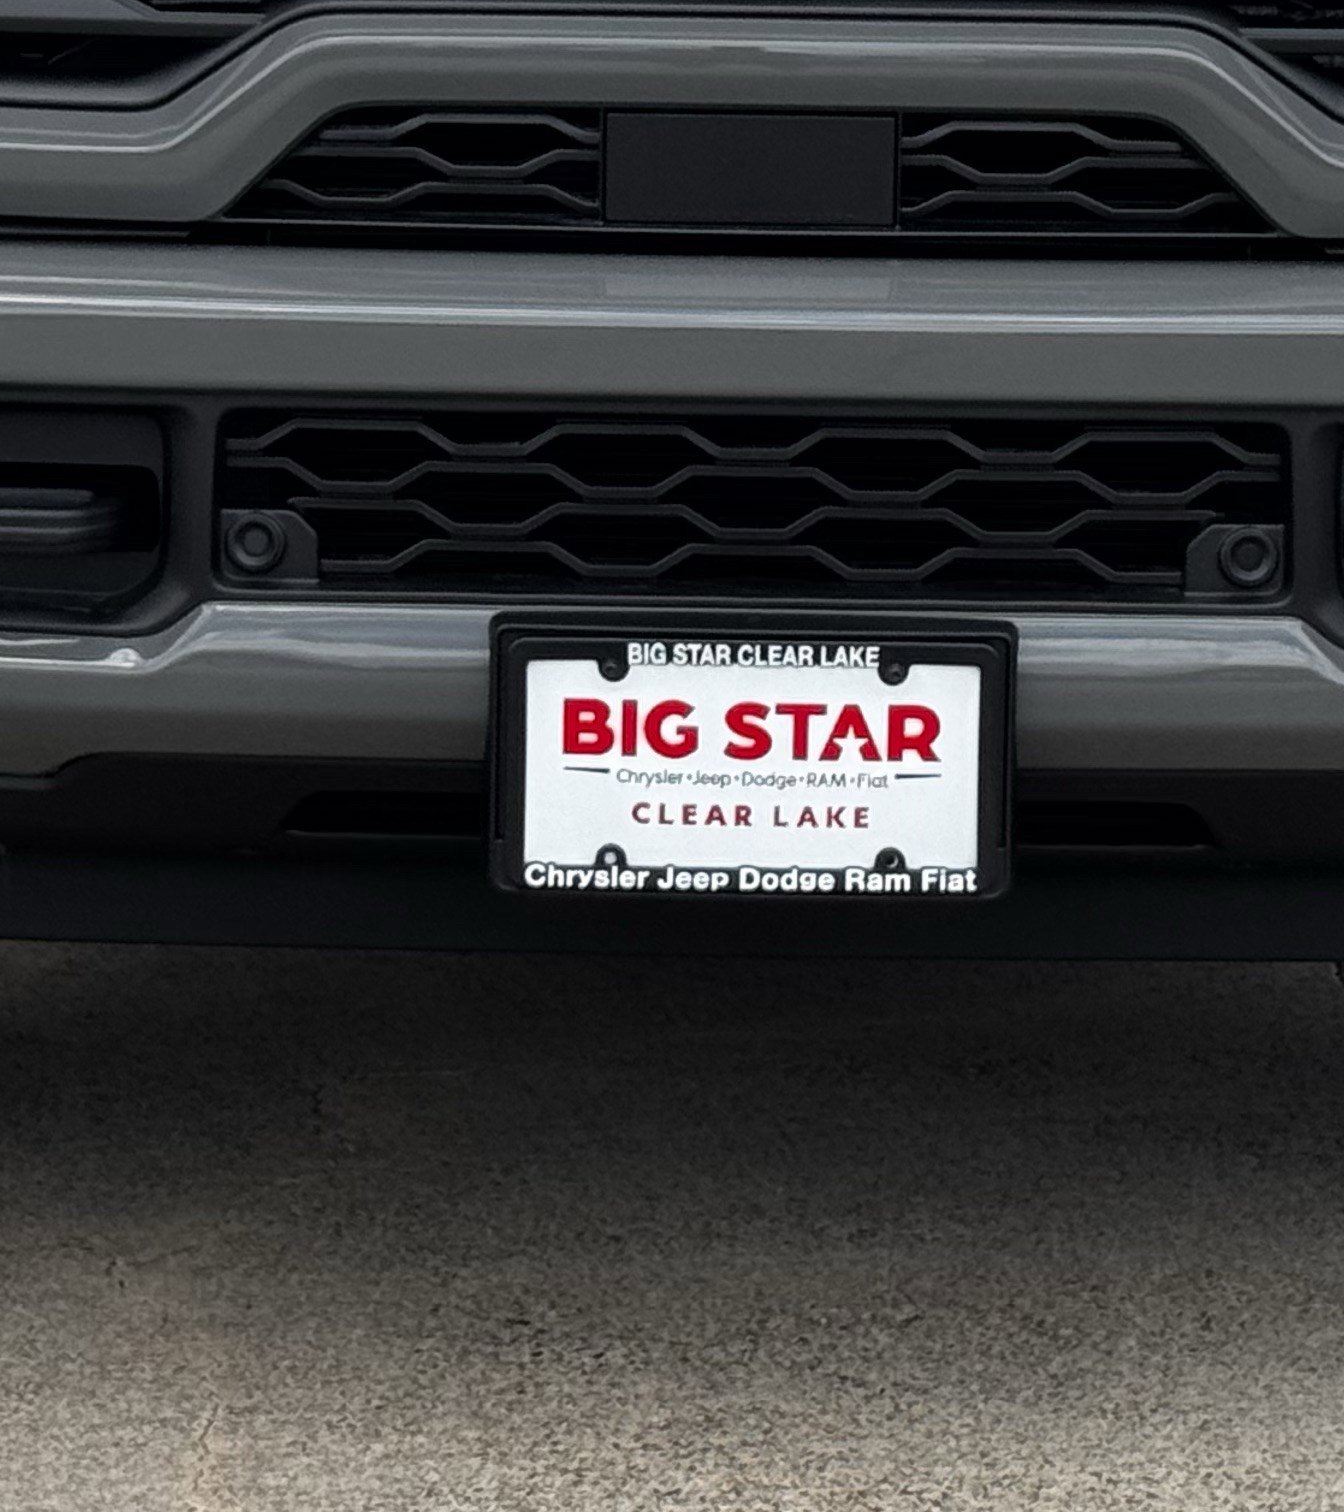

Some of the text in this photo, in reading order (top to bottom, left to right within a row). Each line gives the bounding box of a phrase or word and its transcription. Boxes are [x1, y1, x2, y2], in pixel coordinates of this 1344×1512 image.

[627, 642, 881, 669] BIG STAR CLEAR LAKE
[561, 697, 942, 763] BIG STAR
[631, 801, 871, 829] CLEAR LAKE
[523, 862, 978, 893] Chrysler Jeep Dodge Ram Fiat
